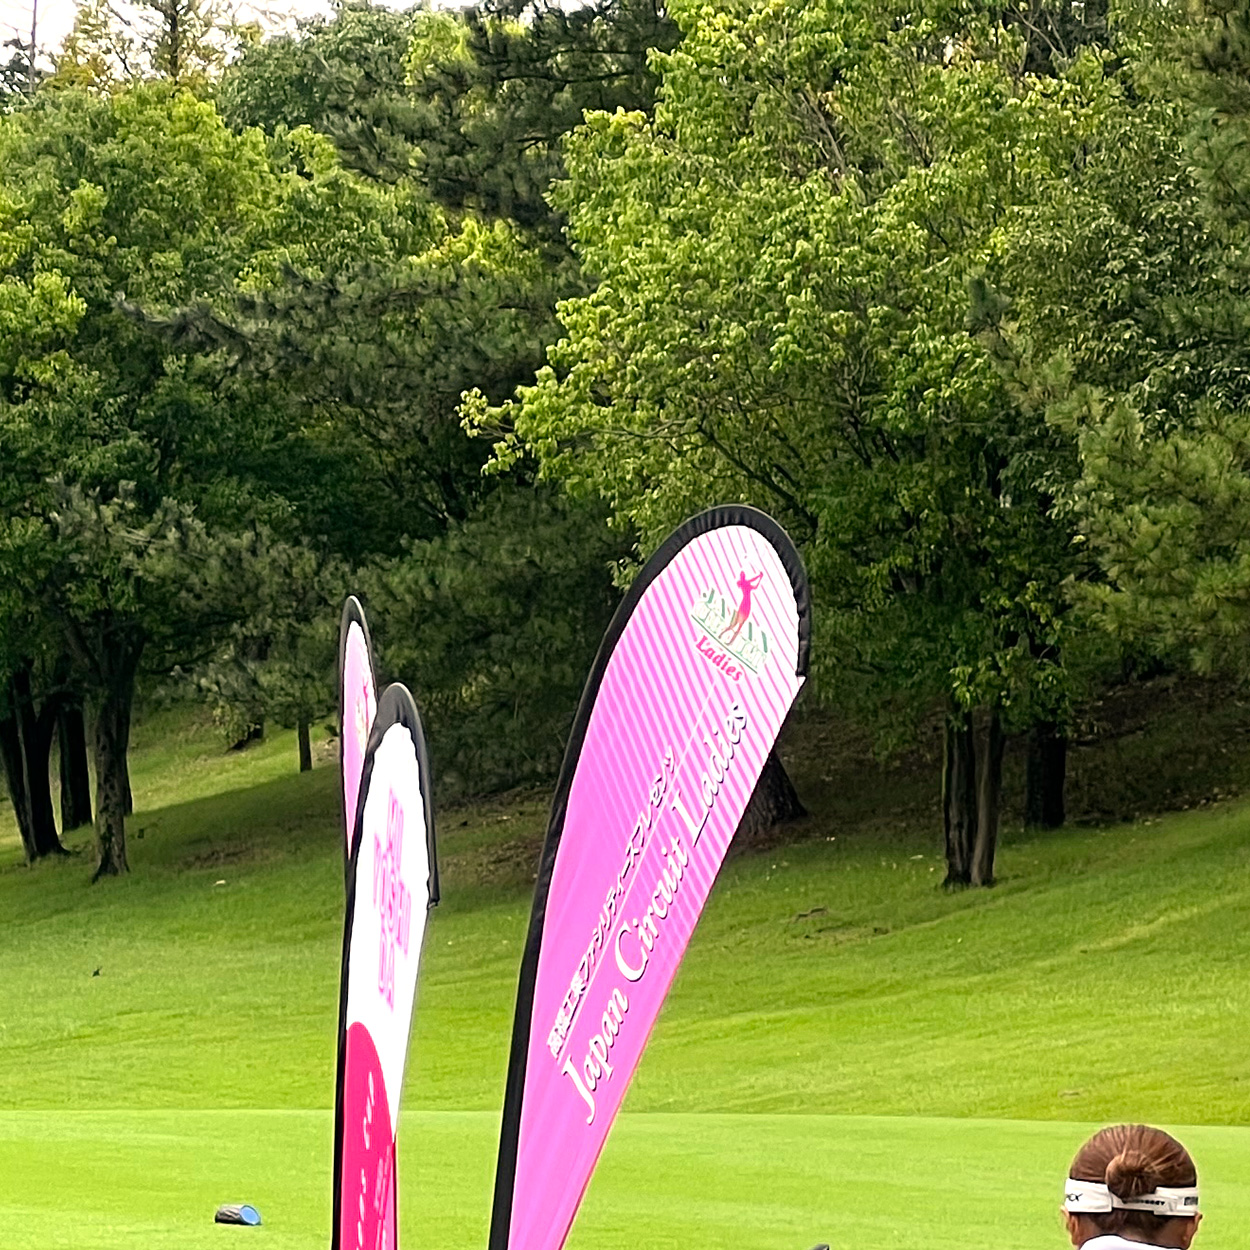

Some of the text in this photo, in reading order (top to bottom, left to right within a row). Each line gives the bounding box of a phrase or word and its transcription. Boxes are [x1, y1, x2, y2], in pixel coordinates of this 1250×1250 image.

[695, 635, 743, 682] Ladies
[561, 987, 630, 1125] Japan
[614, 835, 690, 983] Circuit
[671, 701, 748, 848] Ladies
